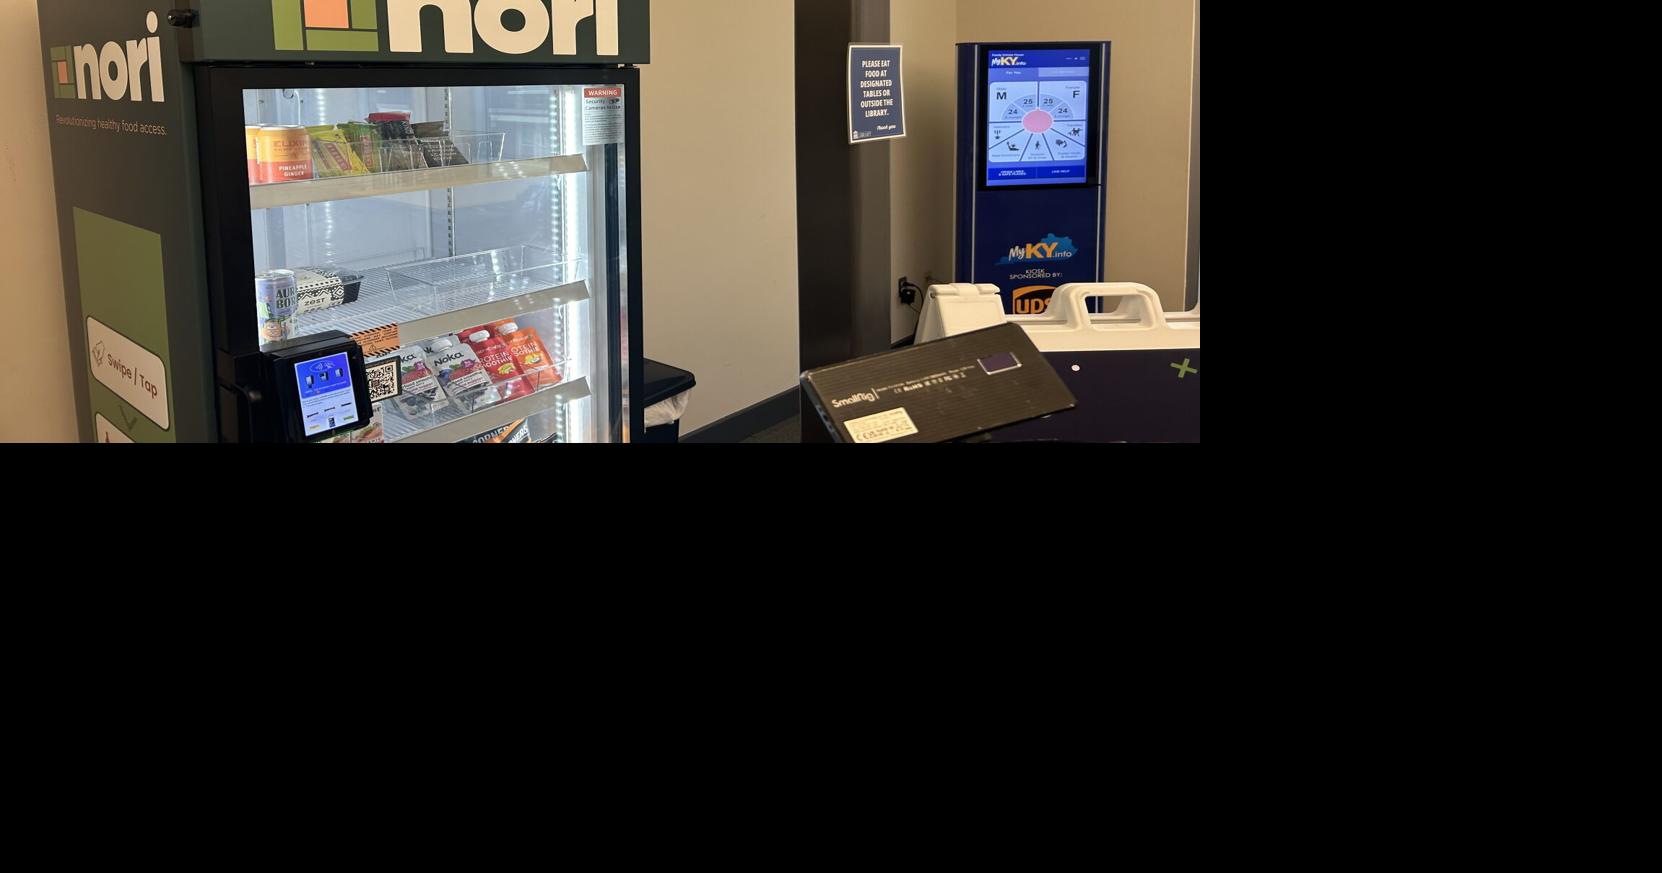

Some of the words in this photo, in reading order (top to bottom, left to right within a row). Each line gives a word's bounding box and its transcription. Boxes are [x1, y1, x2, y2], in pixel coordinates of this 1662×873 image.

[73, 10, 165, 102] nori
[861, 60, 881, 68] PLEASE
[880, 60, 891, 68] EAT
[865, 70, 880, 78] FOOD
[860, 80, 893, 88] DESIGNATED
[863, 90, 882, 98] TABLES
[882, 89, 891, 97] OR
[996, 92, 1007, 100] M
[1072, 90, 1080, 99] F
[883, 99, 894, 107] THE
[865, 109, 890, 118] LIBRARY.
[97, 119, 121, 133] healthy
[121, 119, 138, 132] food
[139, 123, 167, 136] access.
[1009, 272, 1051, 280] SPONSORED
[1015, 297, 1051, 314] UP
[433, 351, 465, 367] Noka
[107, 353, 132, 379] Swipe
[139, 374, 158, 399] Tap
[831, 392, 876, 408] SmallRig
